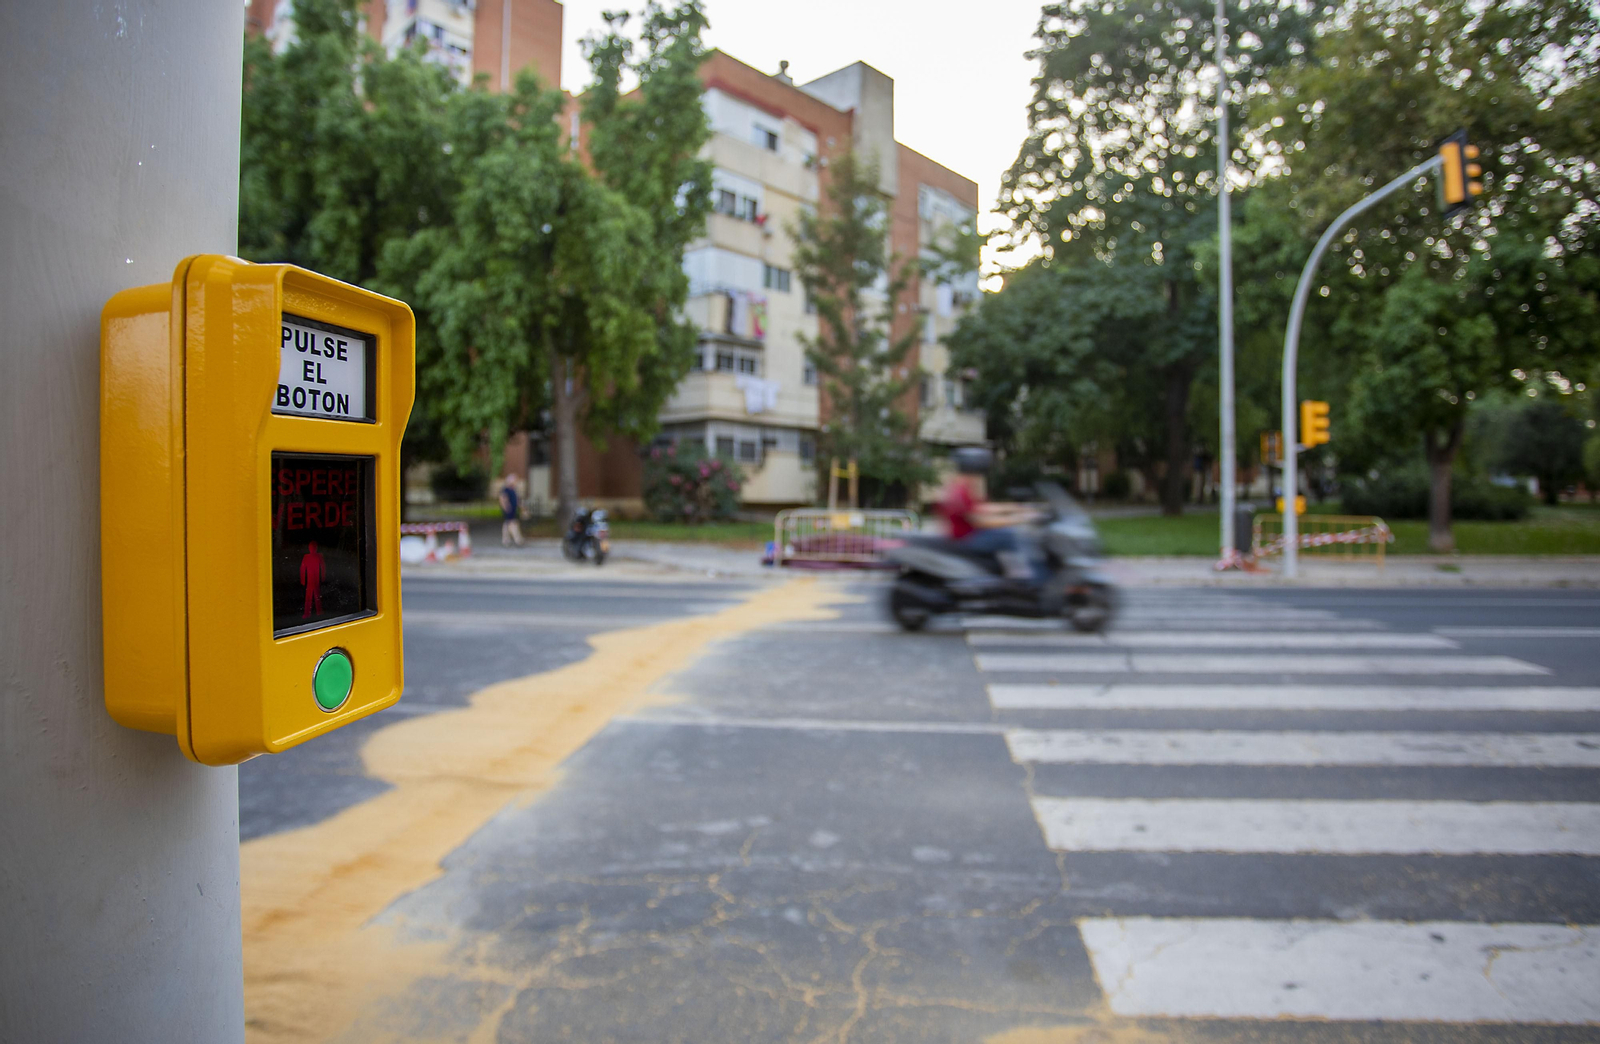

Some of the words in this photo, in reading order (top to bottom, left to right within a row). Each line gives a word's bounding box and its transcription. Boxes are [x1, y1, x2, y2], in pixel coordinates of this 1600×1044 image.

[281, 326, 348, 362] PULSE
[303, 359, 327, 385] EL
[277, 384, 350, 415] BOTON
[271, 468, 358, 496] SPERE
